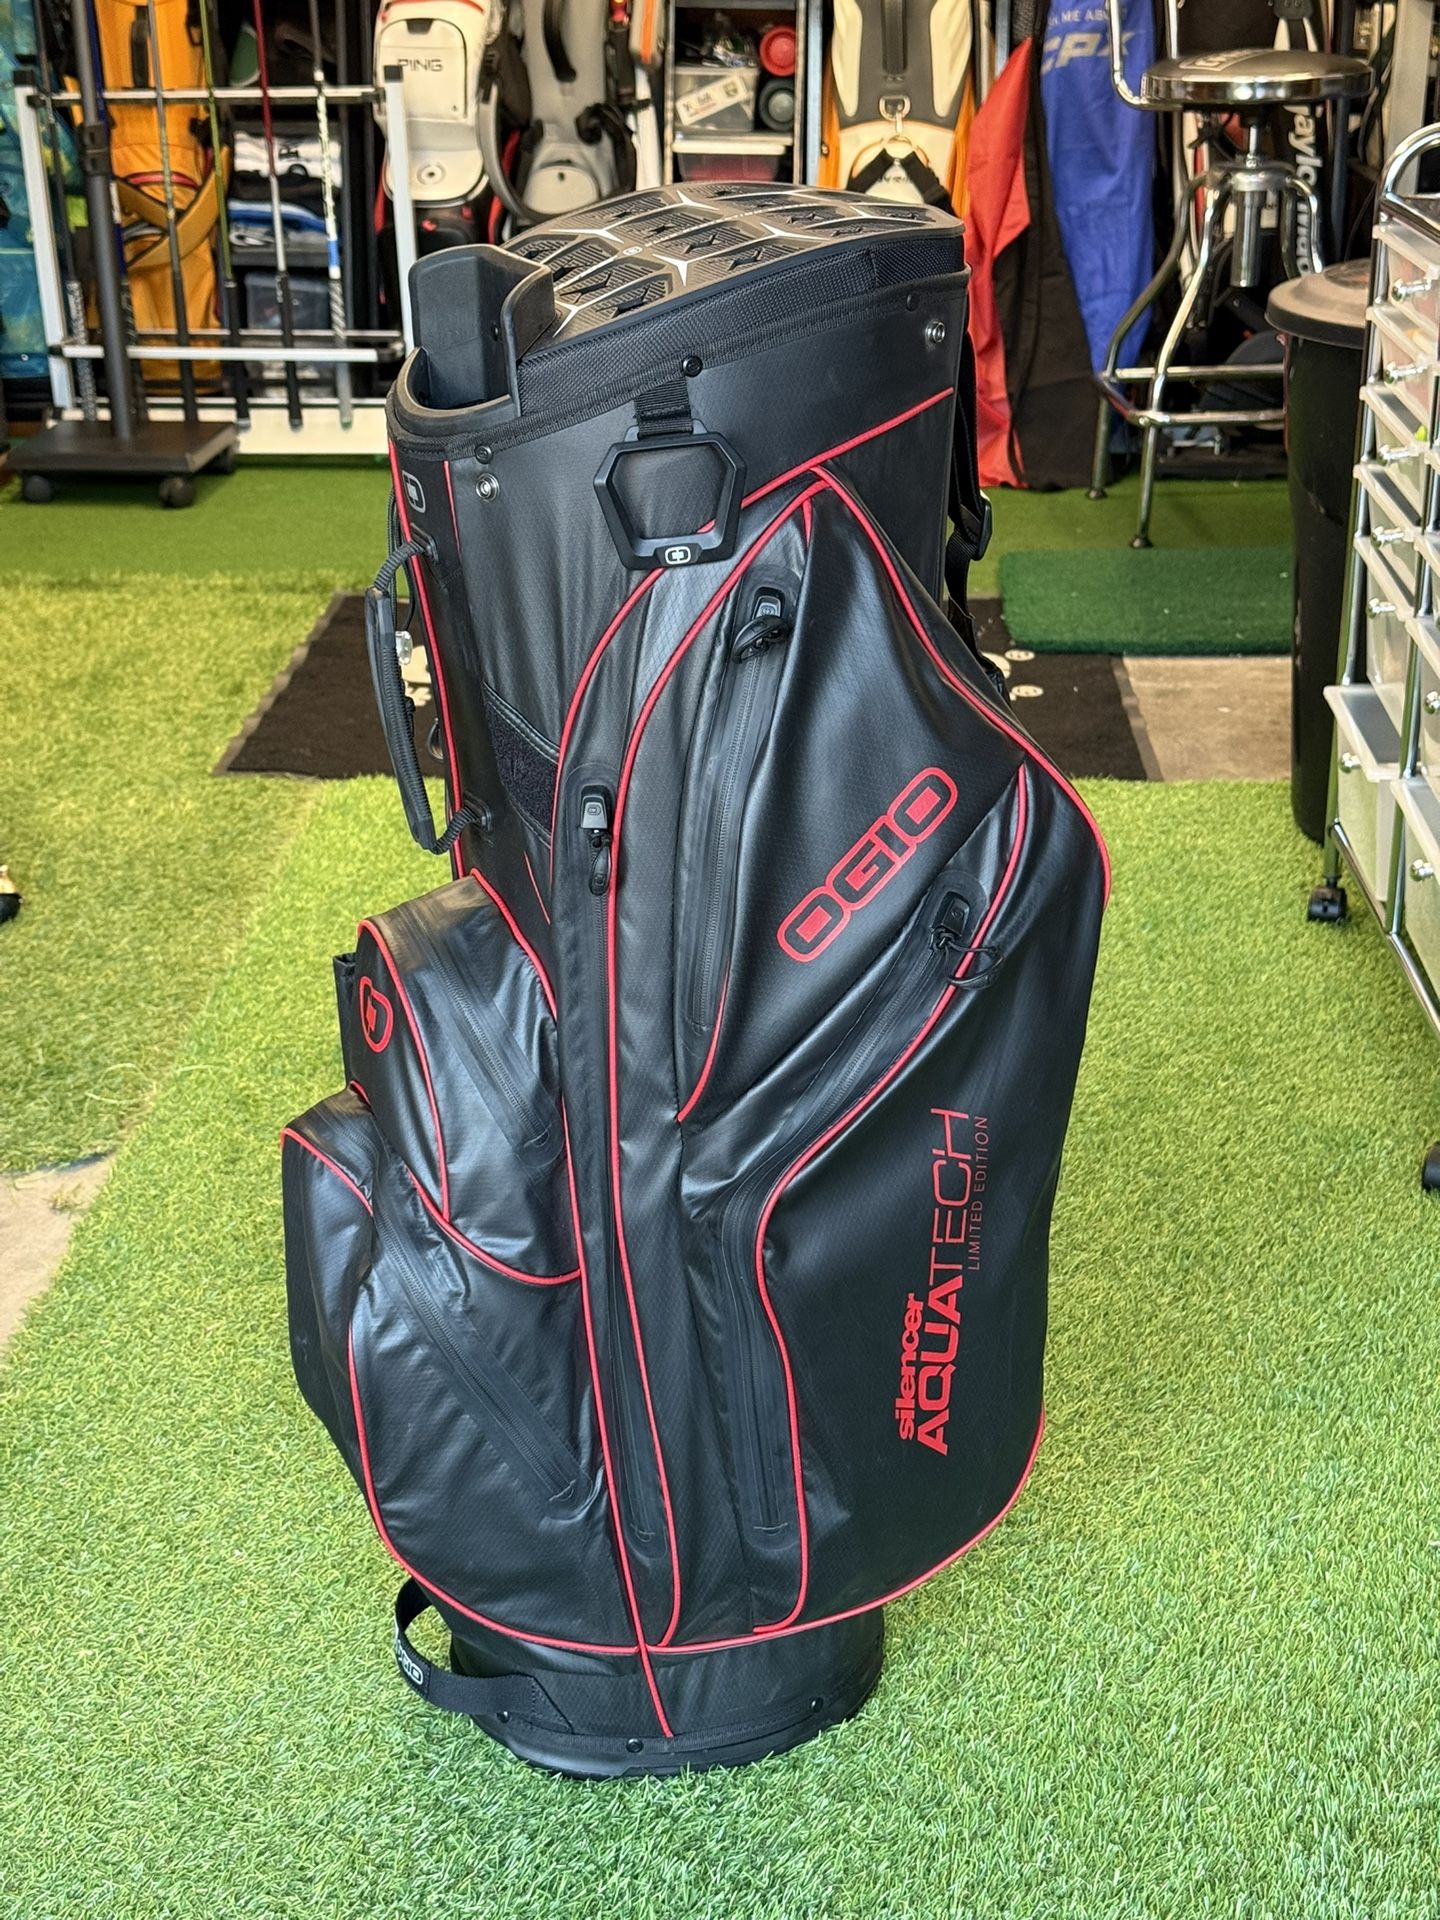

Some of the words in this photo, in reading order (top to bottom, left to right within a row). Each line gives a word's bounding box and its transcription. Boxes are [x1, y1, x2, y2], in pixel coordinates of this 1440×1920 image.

[397, 58, 443, 72] PING
[777, 766, 958, 963] OGIO
[973, 1116, 989, 1192] EDITION
[917, 1107, 972, 1456] AQUATECH
[968, 1200, 983, 1270] LIMITED
[895, 1292, 924, 1440] silencer
